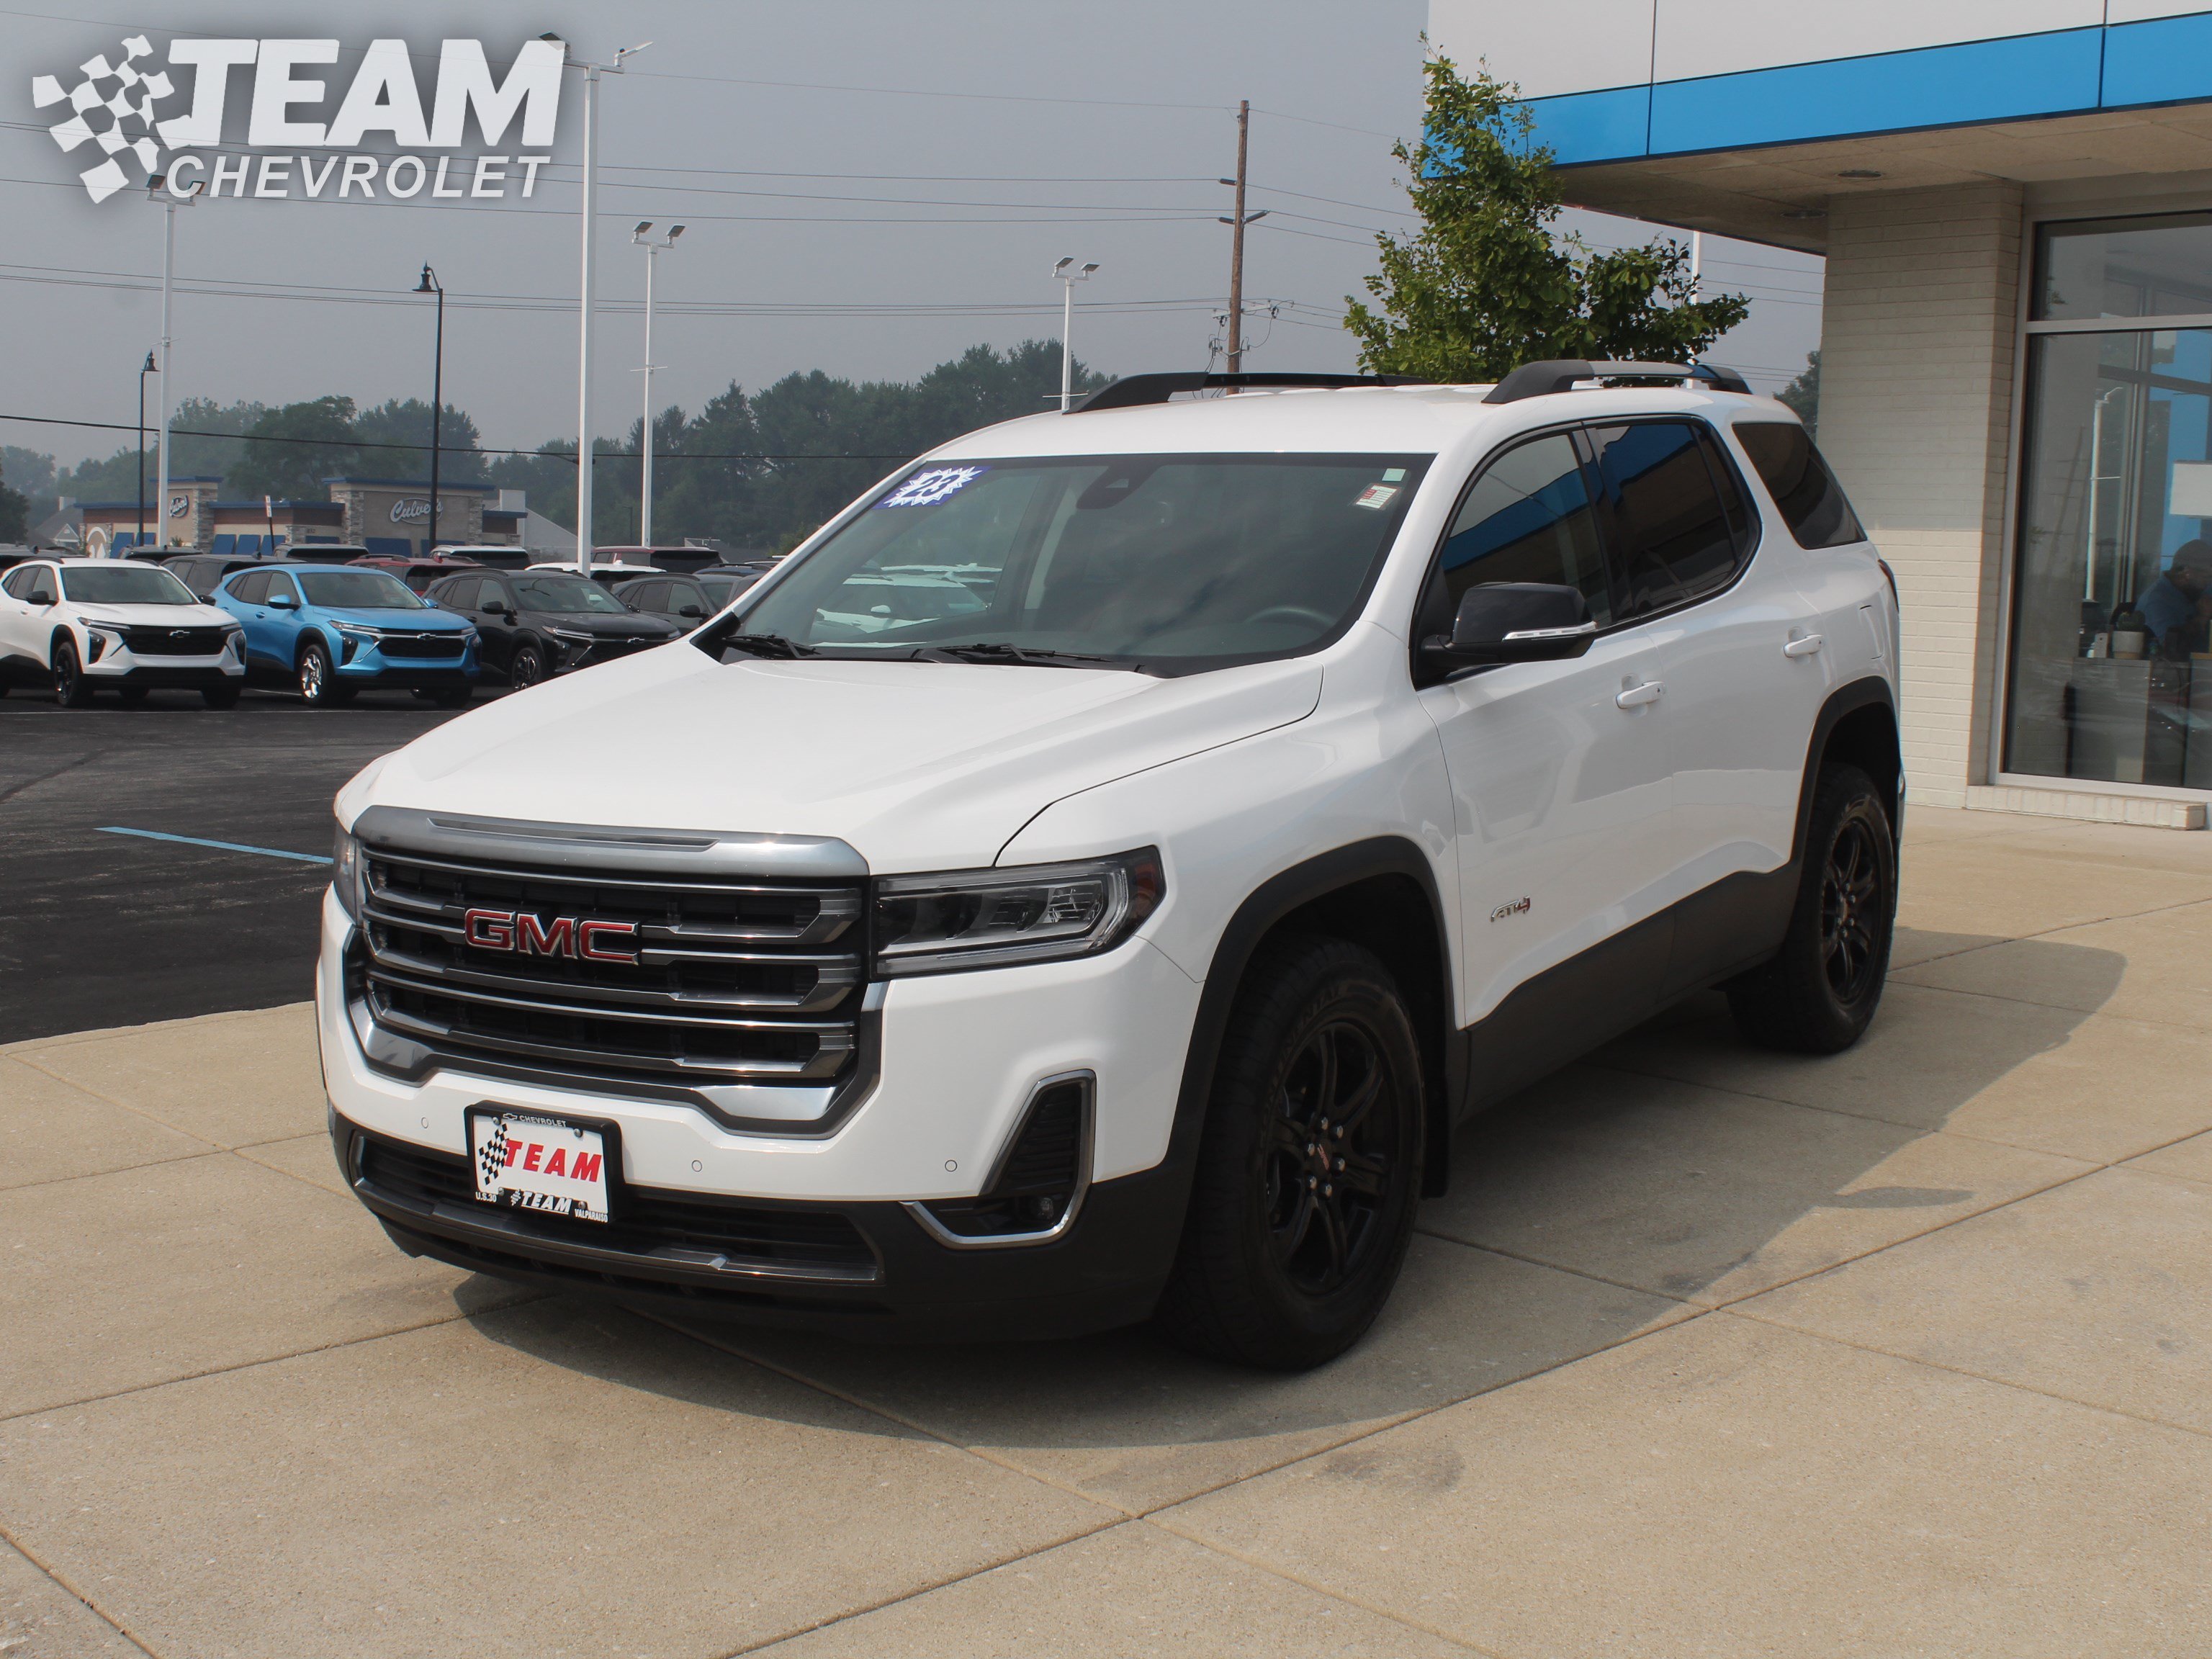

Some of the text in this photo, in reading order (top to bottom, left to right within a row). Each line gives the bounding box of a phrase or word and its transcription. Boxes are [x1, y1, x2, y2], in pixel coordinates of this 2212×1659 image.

[900, 474, 961, 498] 23
[390, 498, 444, 523] Culve's
[464, 908, 639, 966] GMC
[519, 1114, 567, 1128] CHEVROLET
[504, 1138, 602, 1182] TEAM
[521, 1190, 572, 1213] TEAM
[575, 1208, 608, 1223] VALPARAISO
